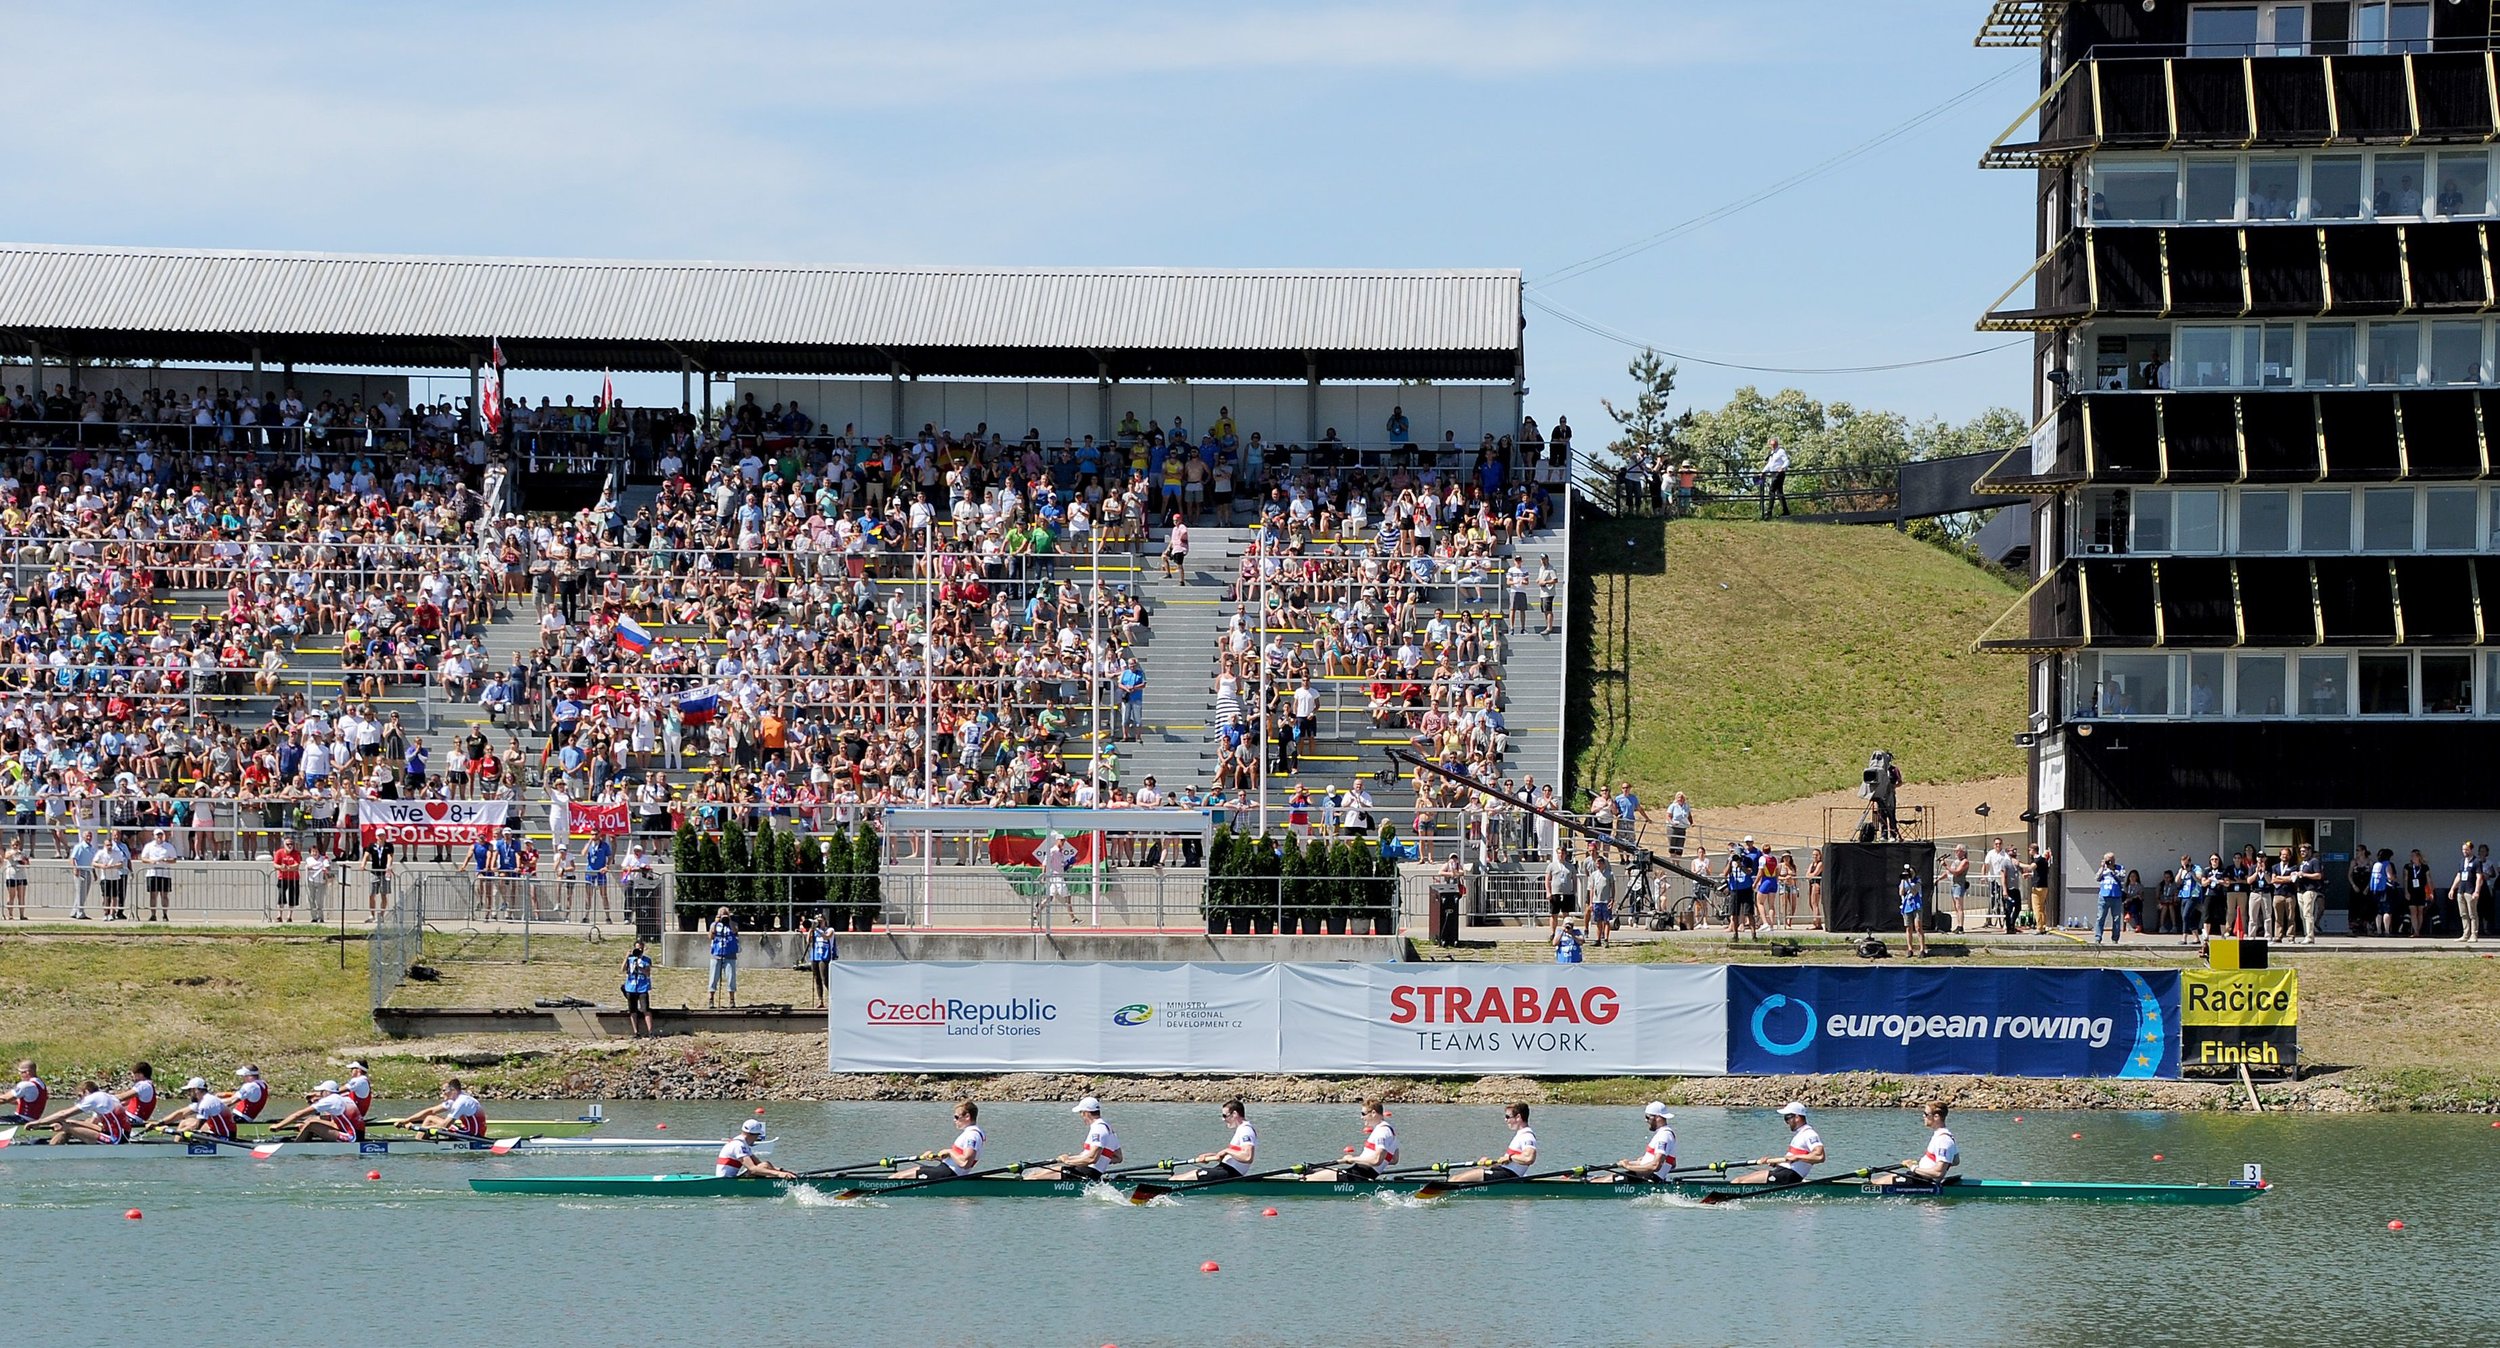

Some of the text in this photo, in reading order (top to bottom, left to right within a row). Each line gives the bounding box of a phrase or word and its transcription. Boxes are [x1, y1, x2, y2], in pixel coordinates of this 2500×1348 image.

[390, 804, 477, 822] We 8+
[598, 812, 626, 829] POL
[384, 826, 482, 843] POLSKA
[2189, 982, 2289, 1012] Račice
[1389, 985, 1620, 1025] STRABAG
[1166, 1011, 1224, 1019] OF REGIONAL
[947, 1024, 1041, 1035] Land of Stories
[1826, 1014, 2113, 1048] european rowing
[1417, 1032, 1596, 1051] TEAMS WORK.
[2201, 1041, 2279, 1065] Finish
[366, 1144, 386, 1152] Enea
[2248, 1165, 2256, 1181] 3
[772, 1180, 794, 1189] wilo
[859, 1180, 899, 1189] Pioneering
[1054, 1182, 1075, 1191] wilo
[1333, 1183, 1355, 1192] wilo
[1614, 1185, 1635, 1194] wilo
[1700, 1186, 1740, 1194] Pioneering
